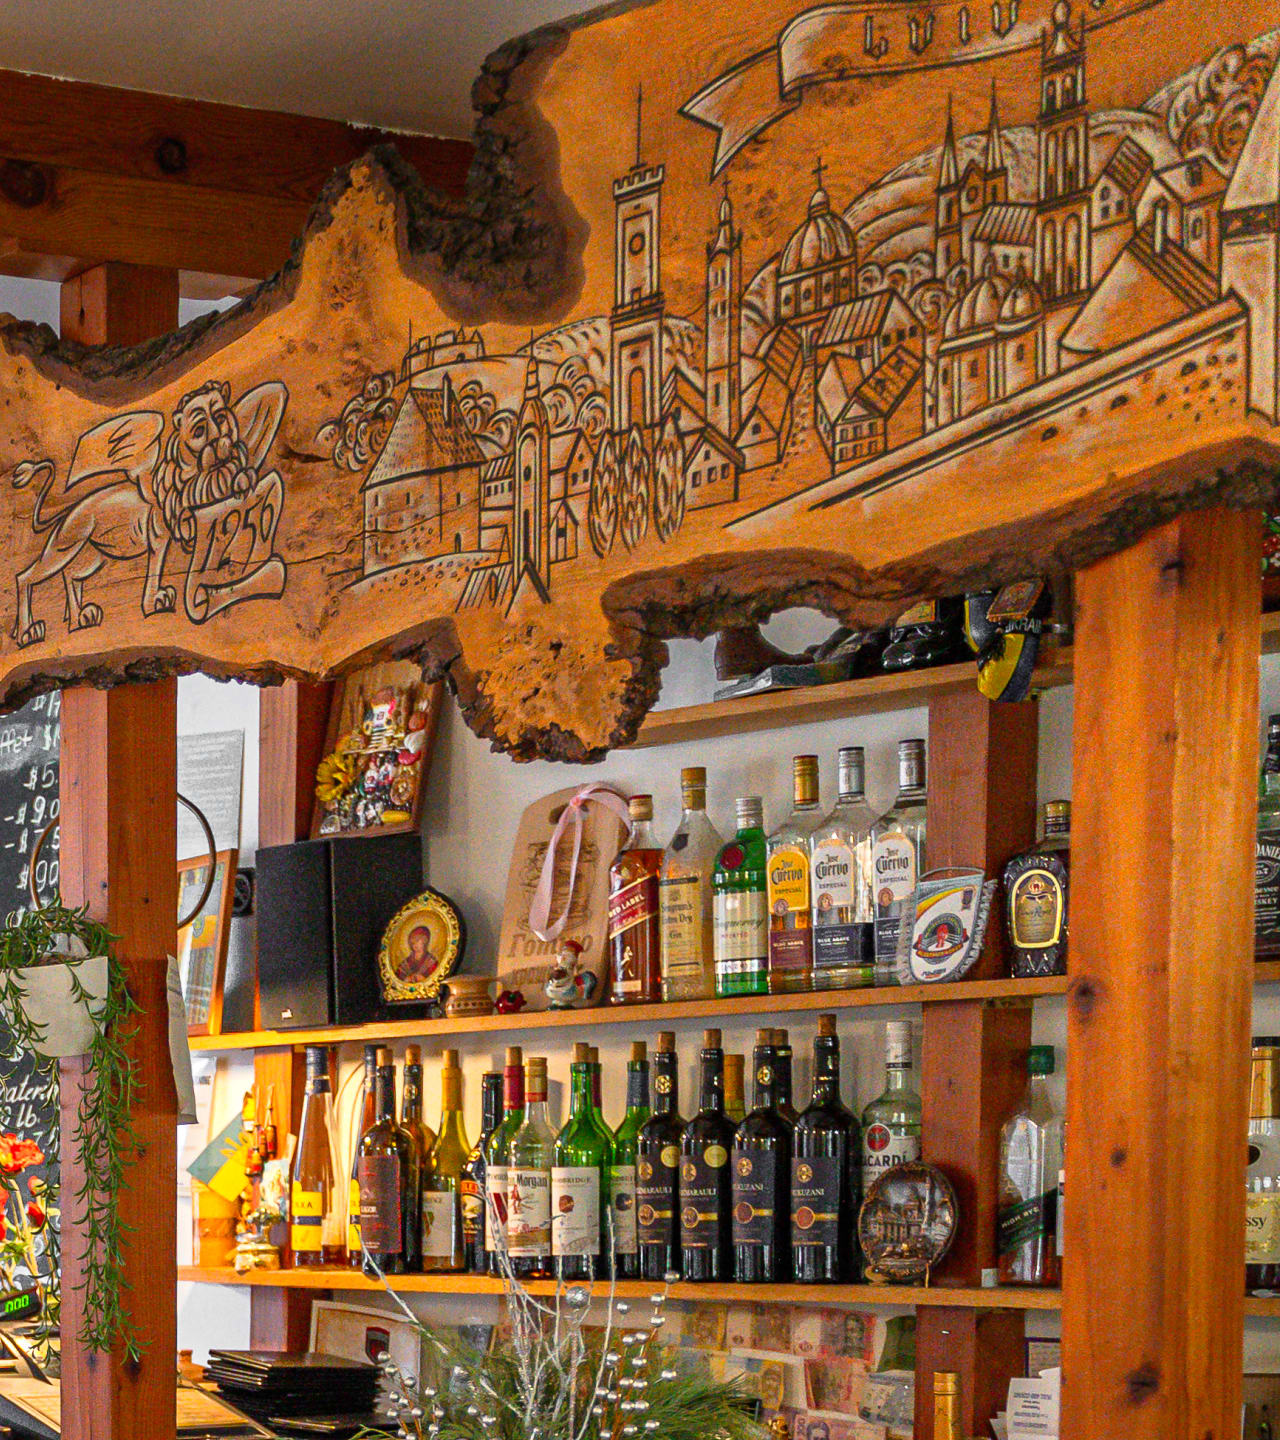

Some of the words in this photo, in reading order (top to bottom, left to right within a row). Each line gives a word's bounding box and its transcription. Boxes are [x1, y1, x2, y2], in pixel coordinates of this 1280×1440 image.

[815, 861, 849, 880] Cuervo
[875, 855, 909, 875] Cuervo
[771, 868, 803, 886] Cuervo
[621, 893, 646, 911] LABEL
[516, 1174, 548, 1188] Morgan
